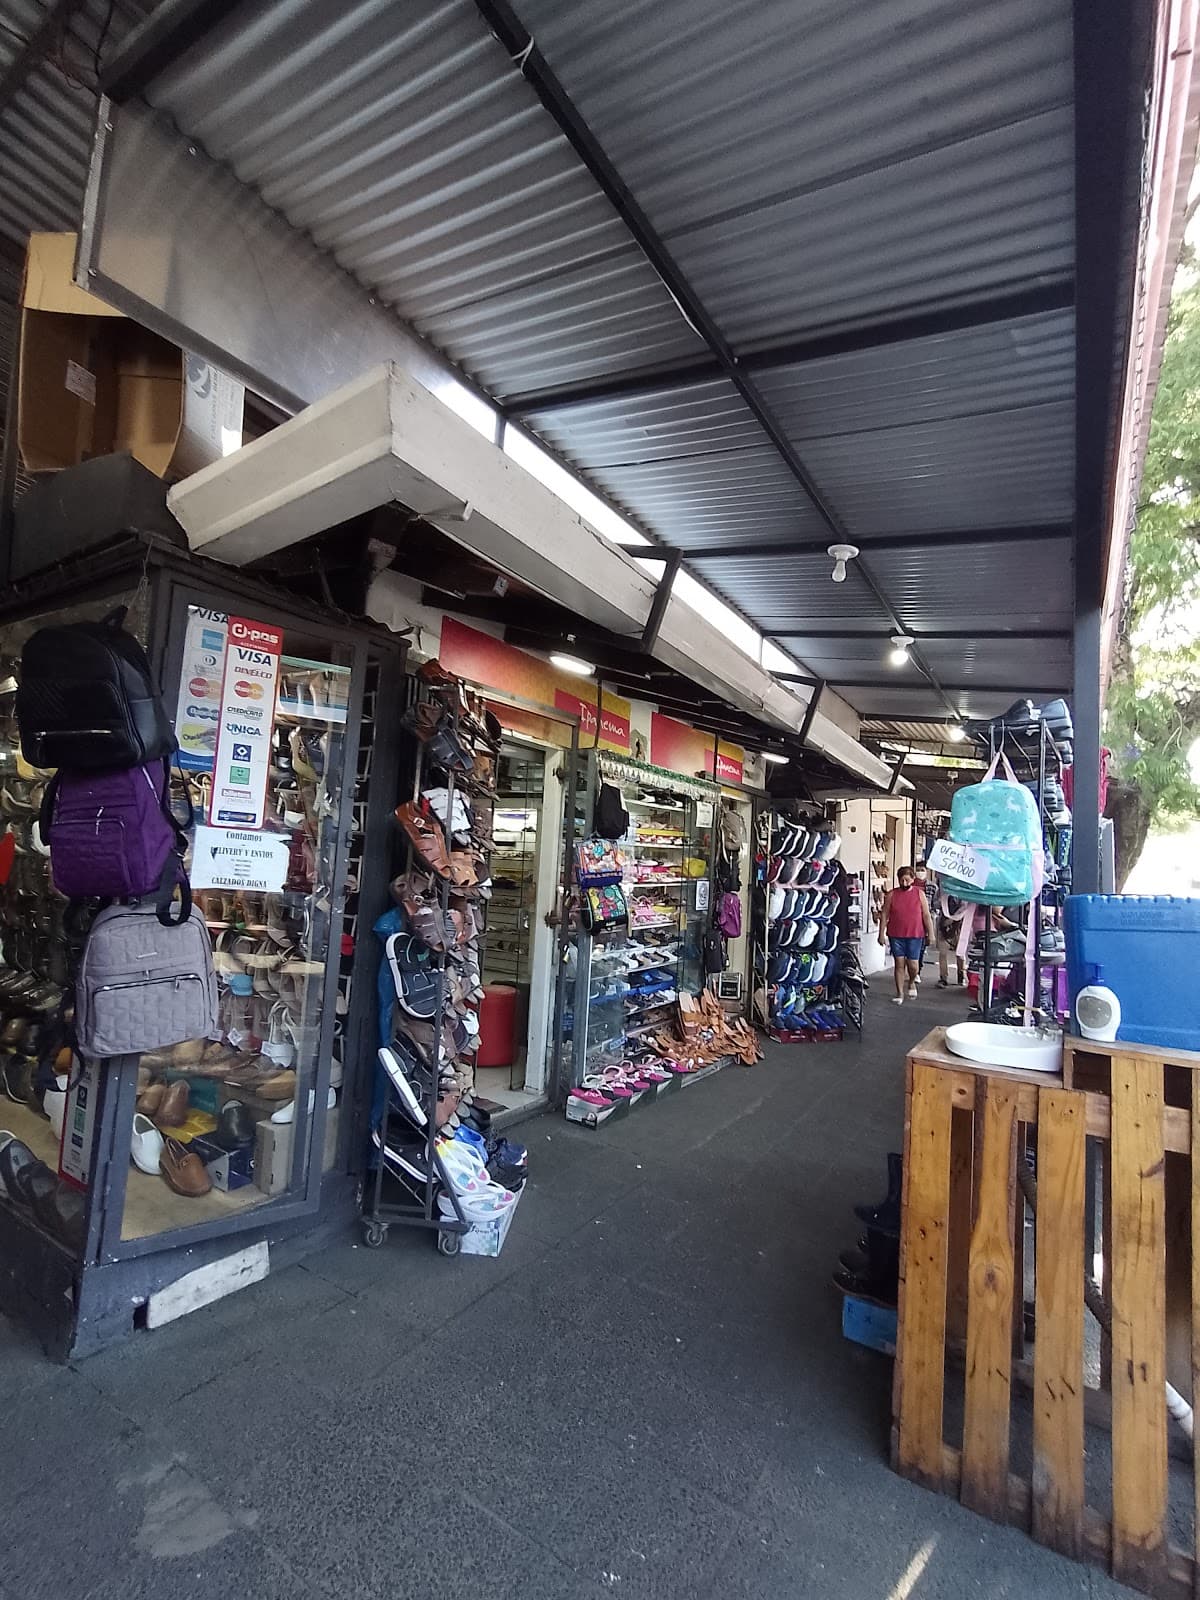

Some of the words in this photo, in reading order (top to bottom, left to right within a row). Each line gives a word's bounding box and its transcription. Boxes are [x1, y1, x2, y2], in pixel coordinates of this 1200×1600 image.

[236, 647, 272, 667] VISA
[226, 830, 262, 842] Contamos
[210, 846, 242, 857] DLIVERY
[211, 876, 245, 887] CALZADOS
